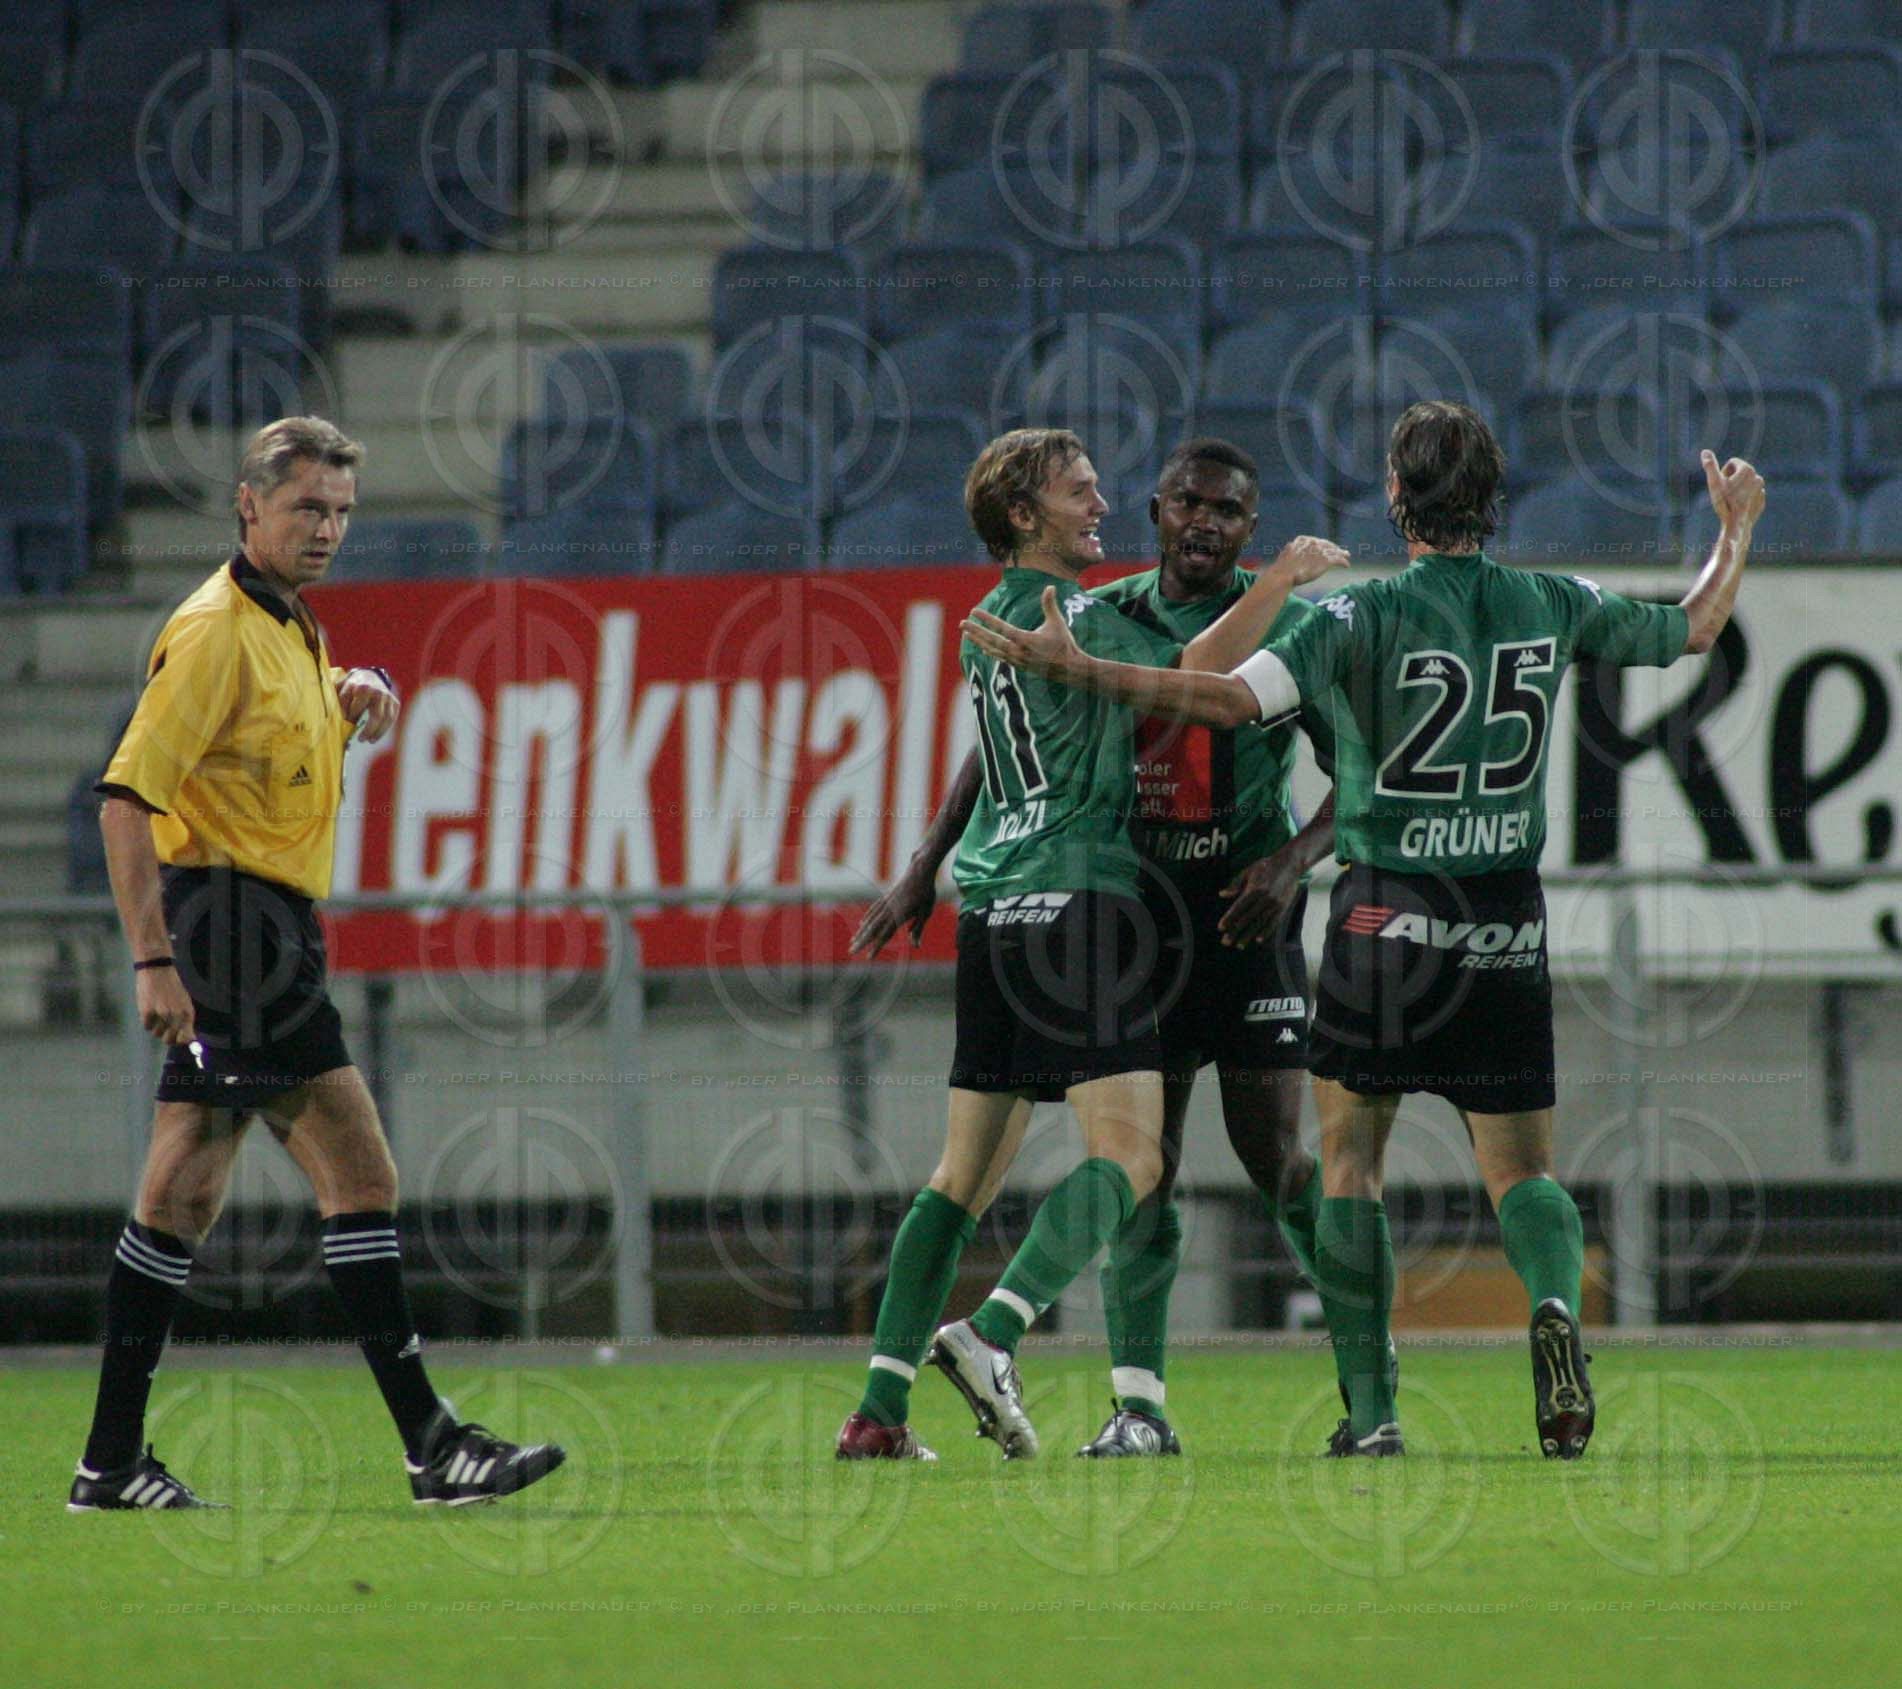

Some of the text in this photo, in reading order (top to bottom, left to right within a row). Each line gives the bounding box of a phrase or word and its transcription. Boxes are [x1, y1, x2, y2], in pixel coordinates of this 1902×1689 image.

[969, 656, 1048, 810] 11
[1375, 637, 1557, 800] 25
[1566, 592, 1901, 952] Re
[1401, 807, 1530, 857] GRÜNER
[986, 907, 1061, 928] REIFEN
[1378, 911, 1545, 954] AVON
[1457, 953, 1538, 970] REIFEN
